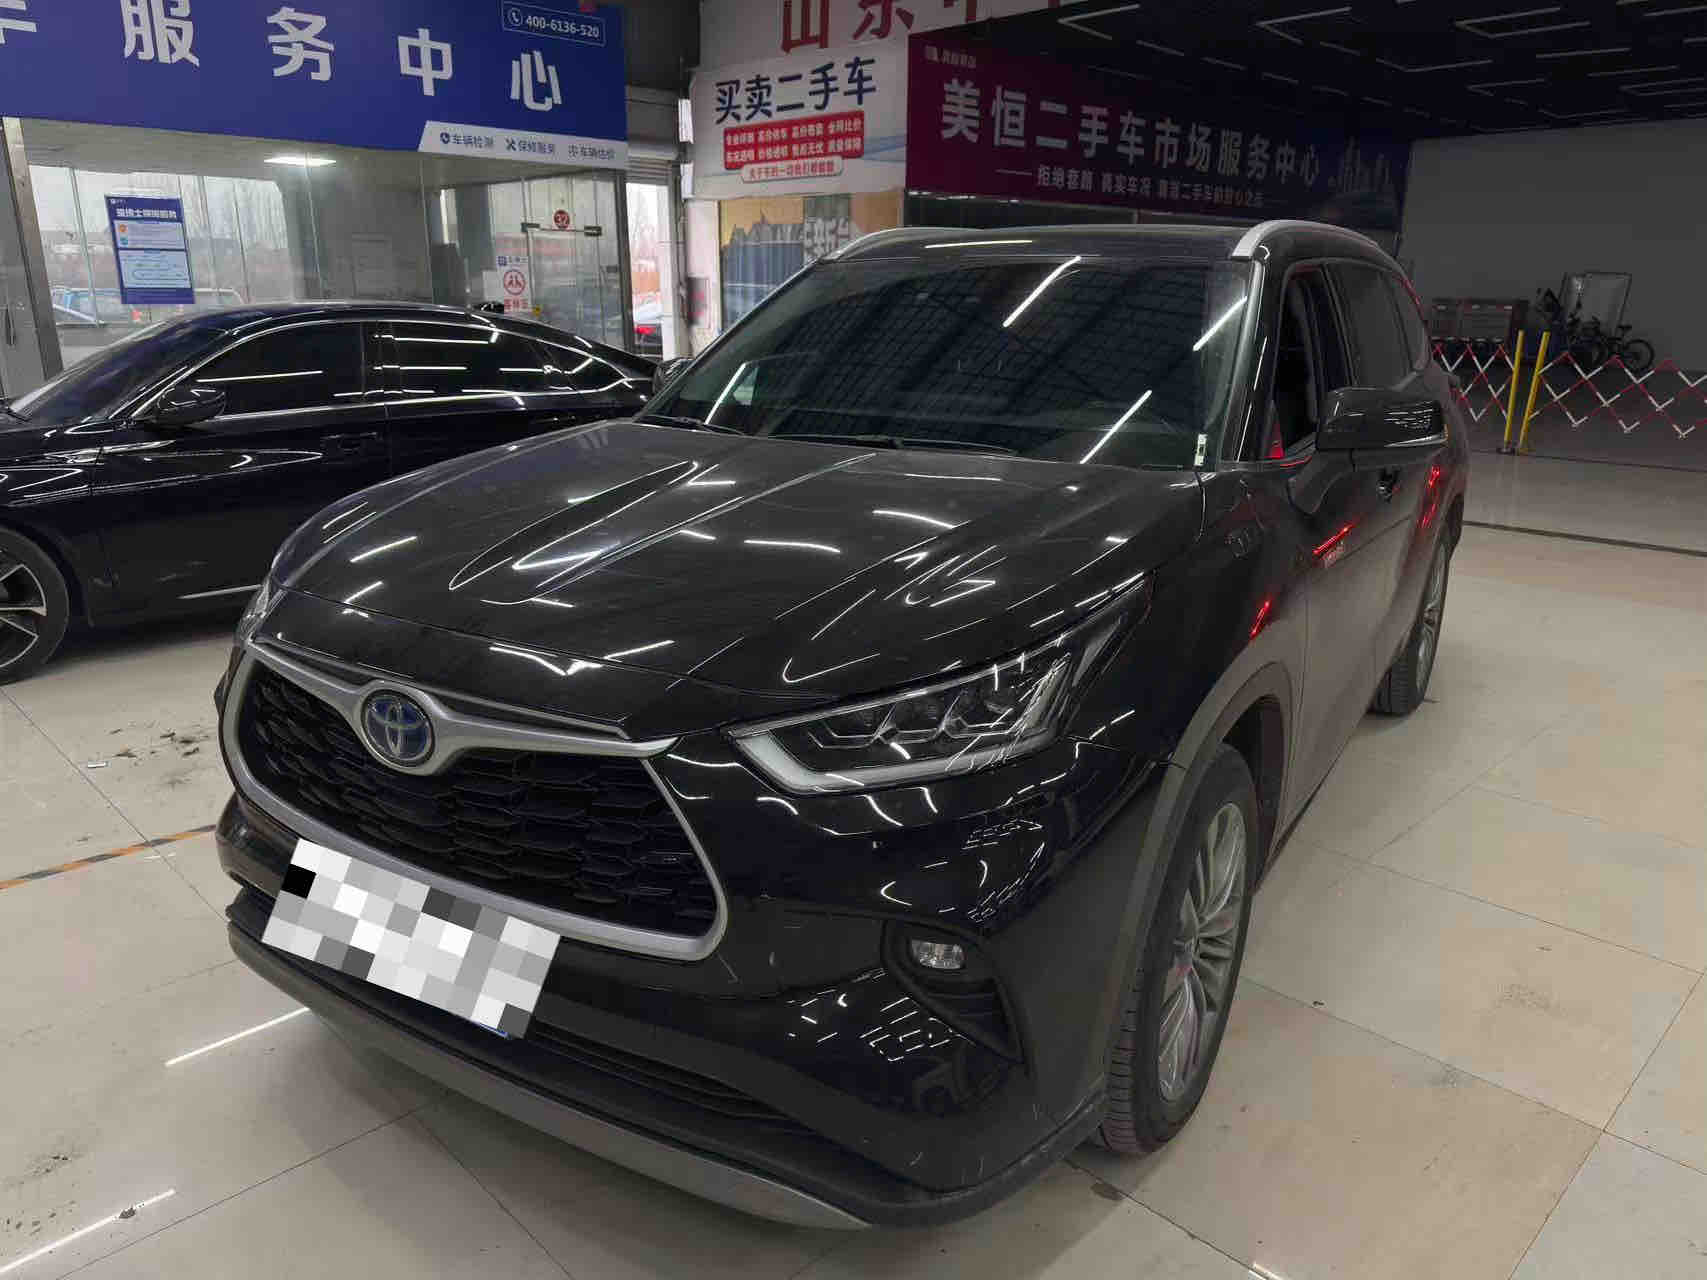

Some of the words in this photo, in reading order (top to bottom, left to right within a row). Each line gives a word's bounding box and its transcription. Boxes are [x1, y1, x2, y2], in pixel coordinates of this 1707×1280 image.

[526, 15, 600, 38] 400-6136-520
[715, 56, 877, 125] 买卖二手车
[941, 78, 1320, 186] 美恒二手车市场服务中心
